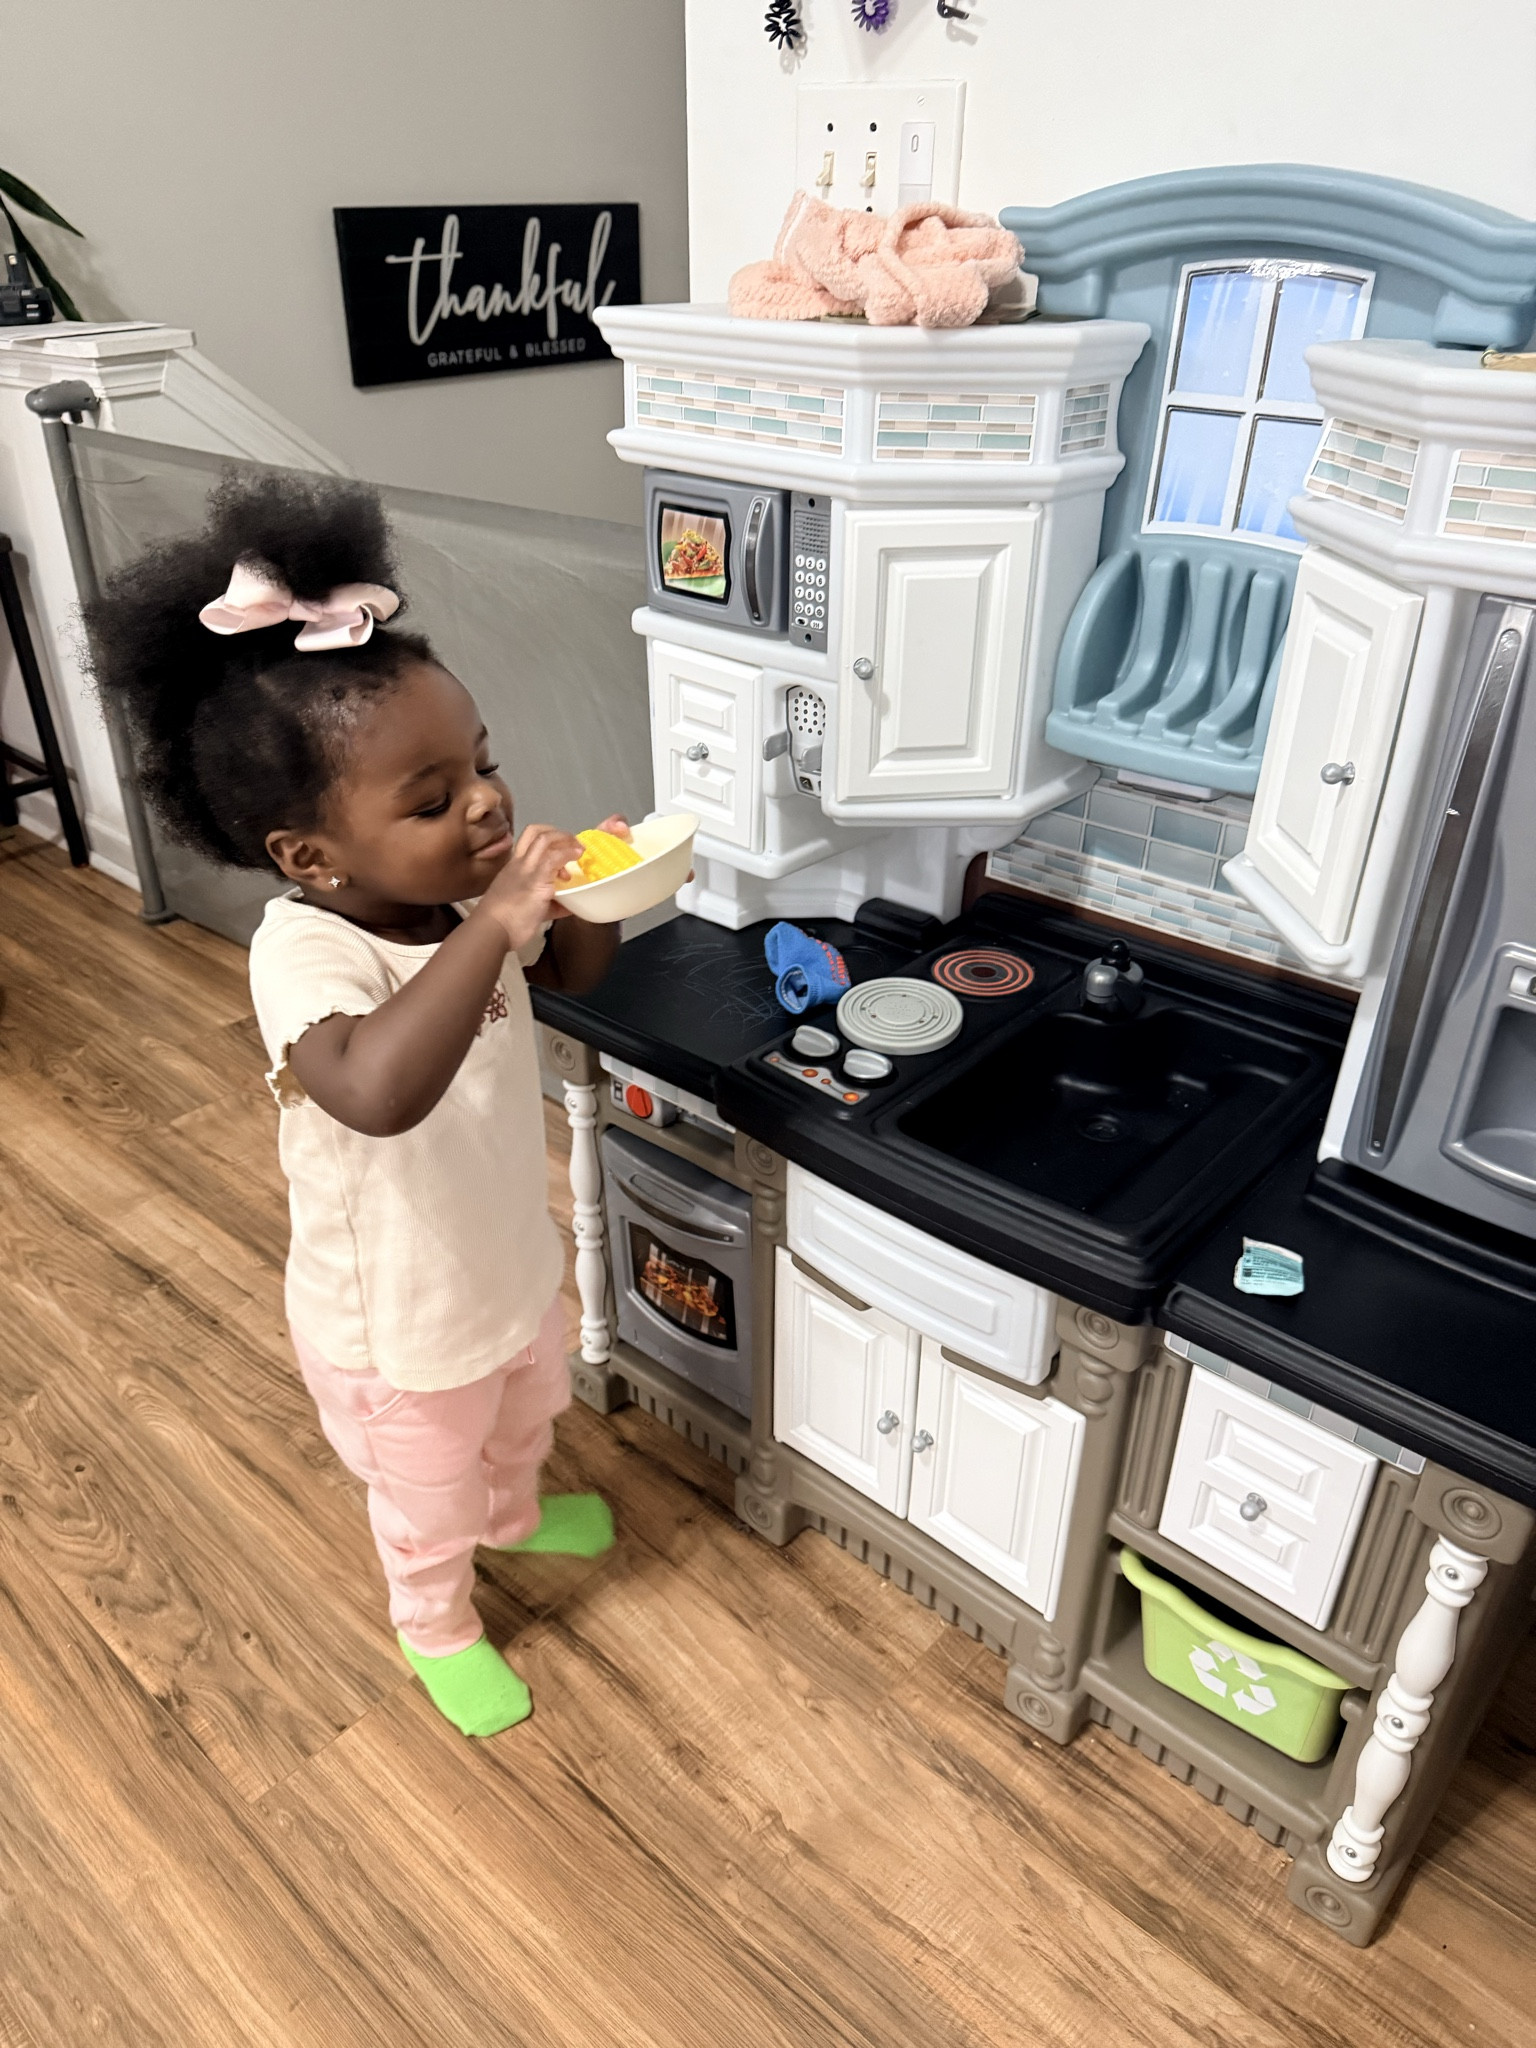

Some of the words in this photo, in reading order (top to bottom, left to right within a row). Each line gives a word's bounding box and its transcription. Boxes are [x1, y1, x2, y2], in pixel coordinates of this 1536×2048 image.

[385, 210, 616, 346] thankful
[427, 347, 502, 368] GRATEFUL
[509, 344, 518, 359] &
[525, 337, 586, 358] BLESSED
